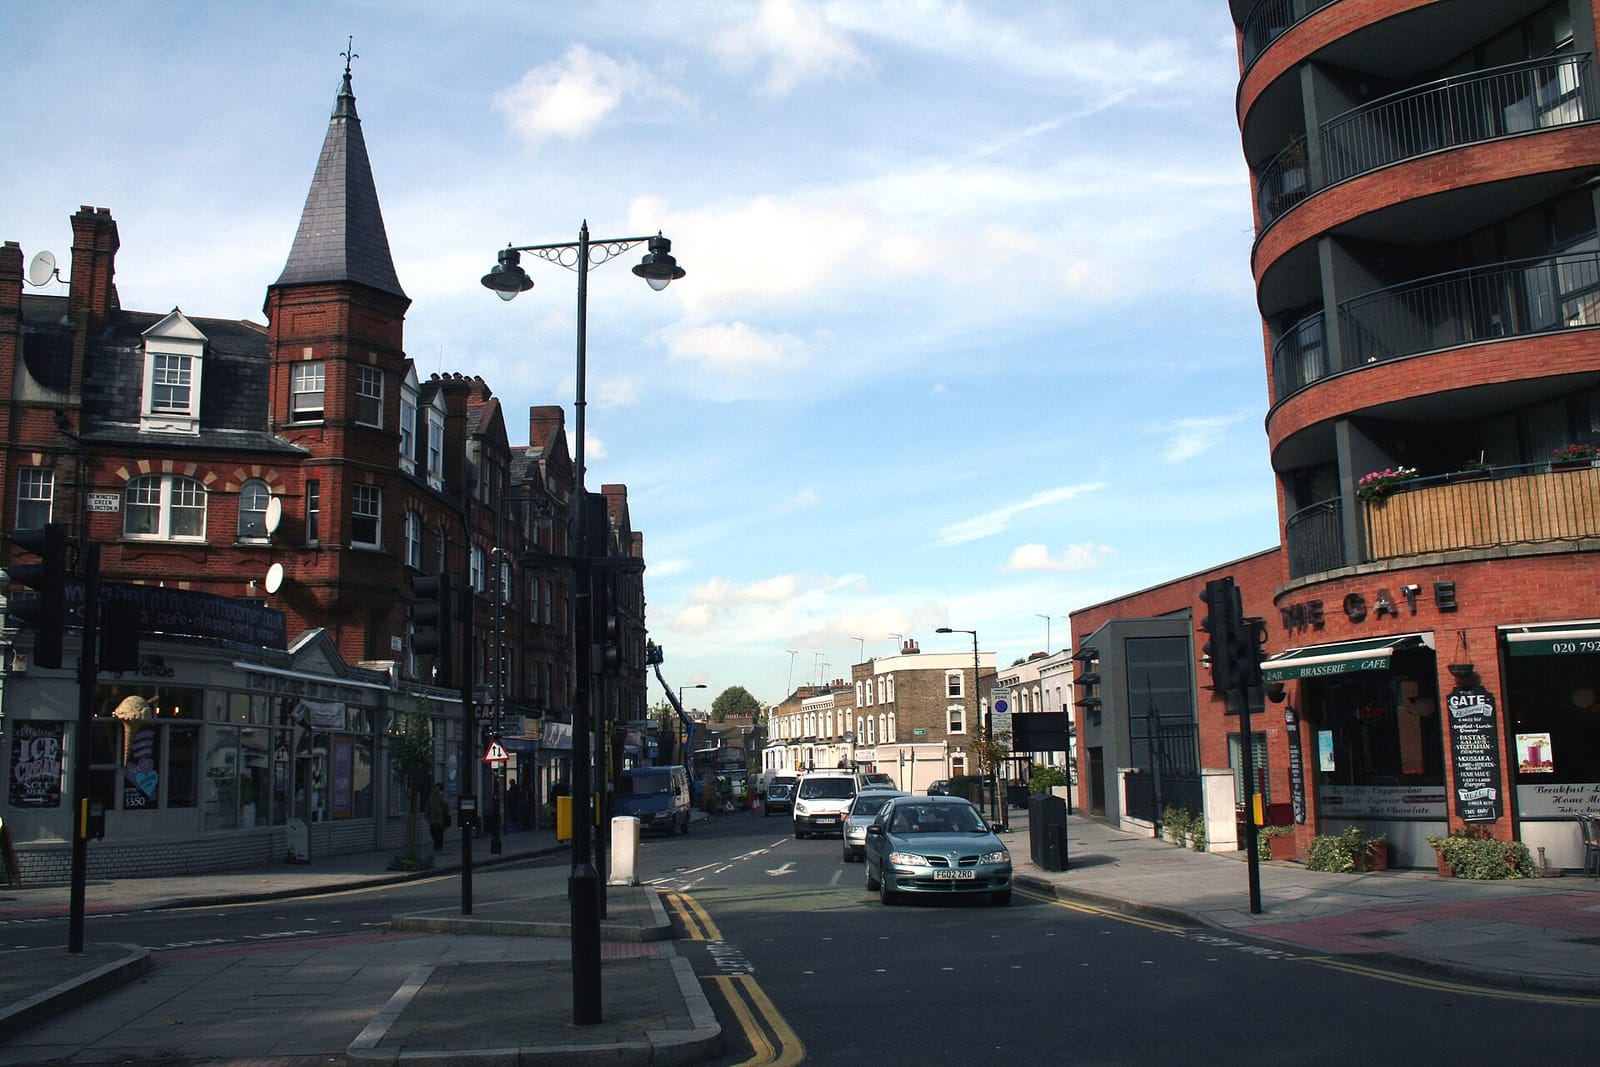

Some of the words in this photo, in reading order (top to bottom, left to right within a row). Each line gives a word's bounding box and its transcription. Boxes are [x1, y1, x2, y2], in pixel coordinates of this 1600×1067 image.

[1281, 600, 1325, 634] THE
[1344, 580, 1457, 624] GATE
[1553, 642, 1576, 654] 020
[1300, 663, 1347, 678] BRASSERIE
[1361, 659, 1387, 670] CAFE
[1450, 695, 1485, 706] GATE
[18, 738, 58, 762] ICE
[14, 760, 61, 784] CREAM
[1536, 785, 1584, 795] Breakfast
[1552, 795, 1584, 804] Home
